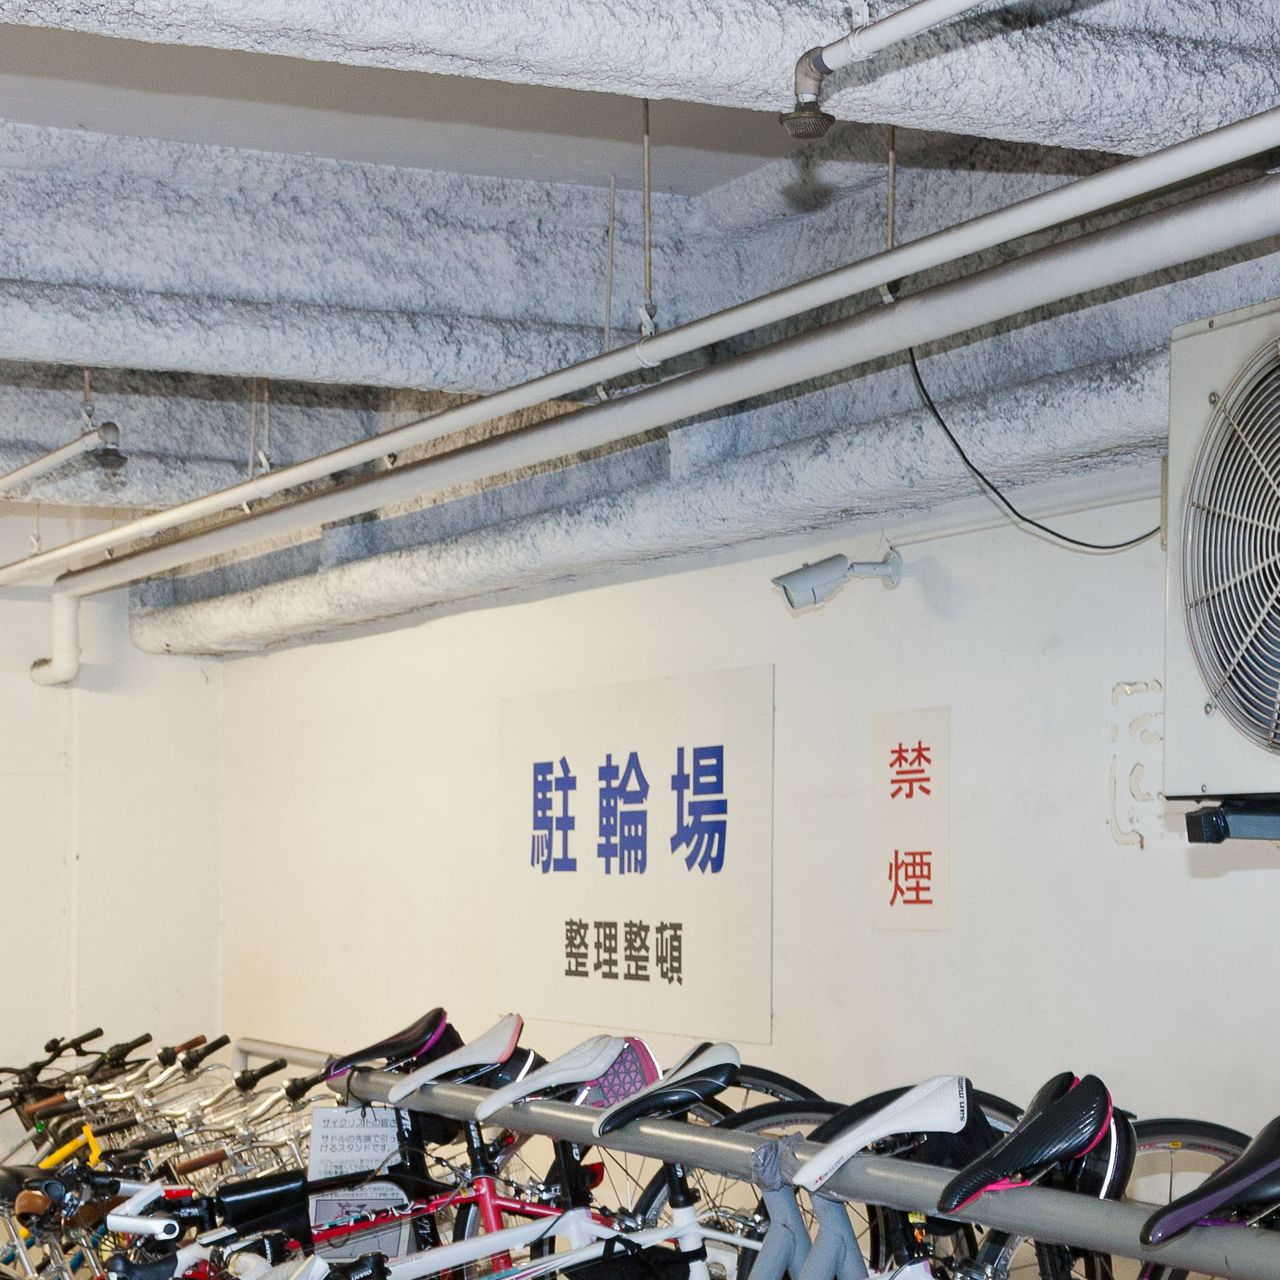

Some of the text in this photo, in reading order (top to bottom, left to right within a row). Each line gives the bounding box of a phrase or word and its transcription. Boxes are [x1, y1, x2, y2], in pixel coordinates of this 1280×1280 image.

[531, 744, 729, 876] 駐輪場
[888, 740, 934, 907] 禁煙
[564, 918, 684, 986] 整理整頓
